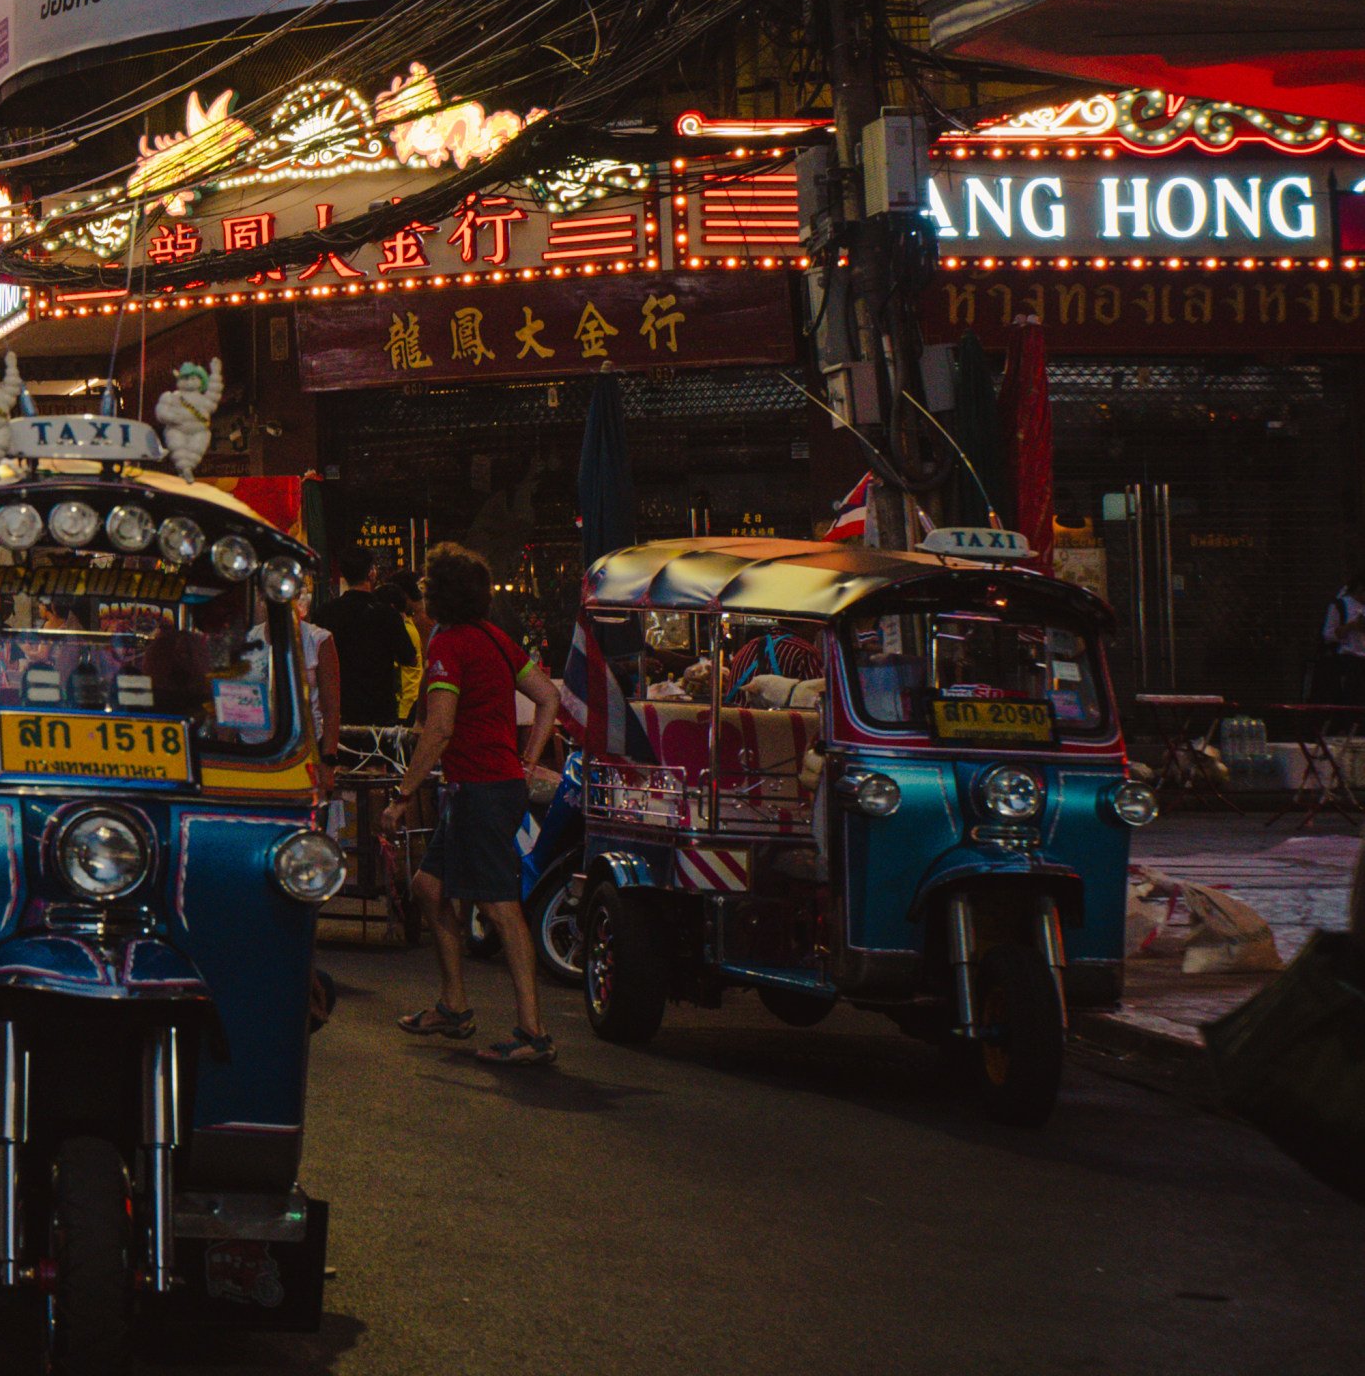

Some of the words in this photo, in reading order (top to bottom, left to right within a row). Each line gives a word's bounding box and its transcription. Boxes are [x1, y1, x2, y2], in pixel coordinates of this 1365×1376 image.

[1100, 176, 1317, 239] HONG
[381, 293, 686, 370] 龍鳳大金行
[31, 422, 131, 446] TAXI
[951, 531, 1017, 550] TAXI
[989, 703, 1048, 725] 2090
[18, 716, 71, 749] สก
[96, 721, 182, 755] 1518
